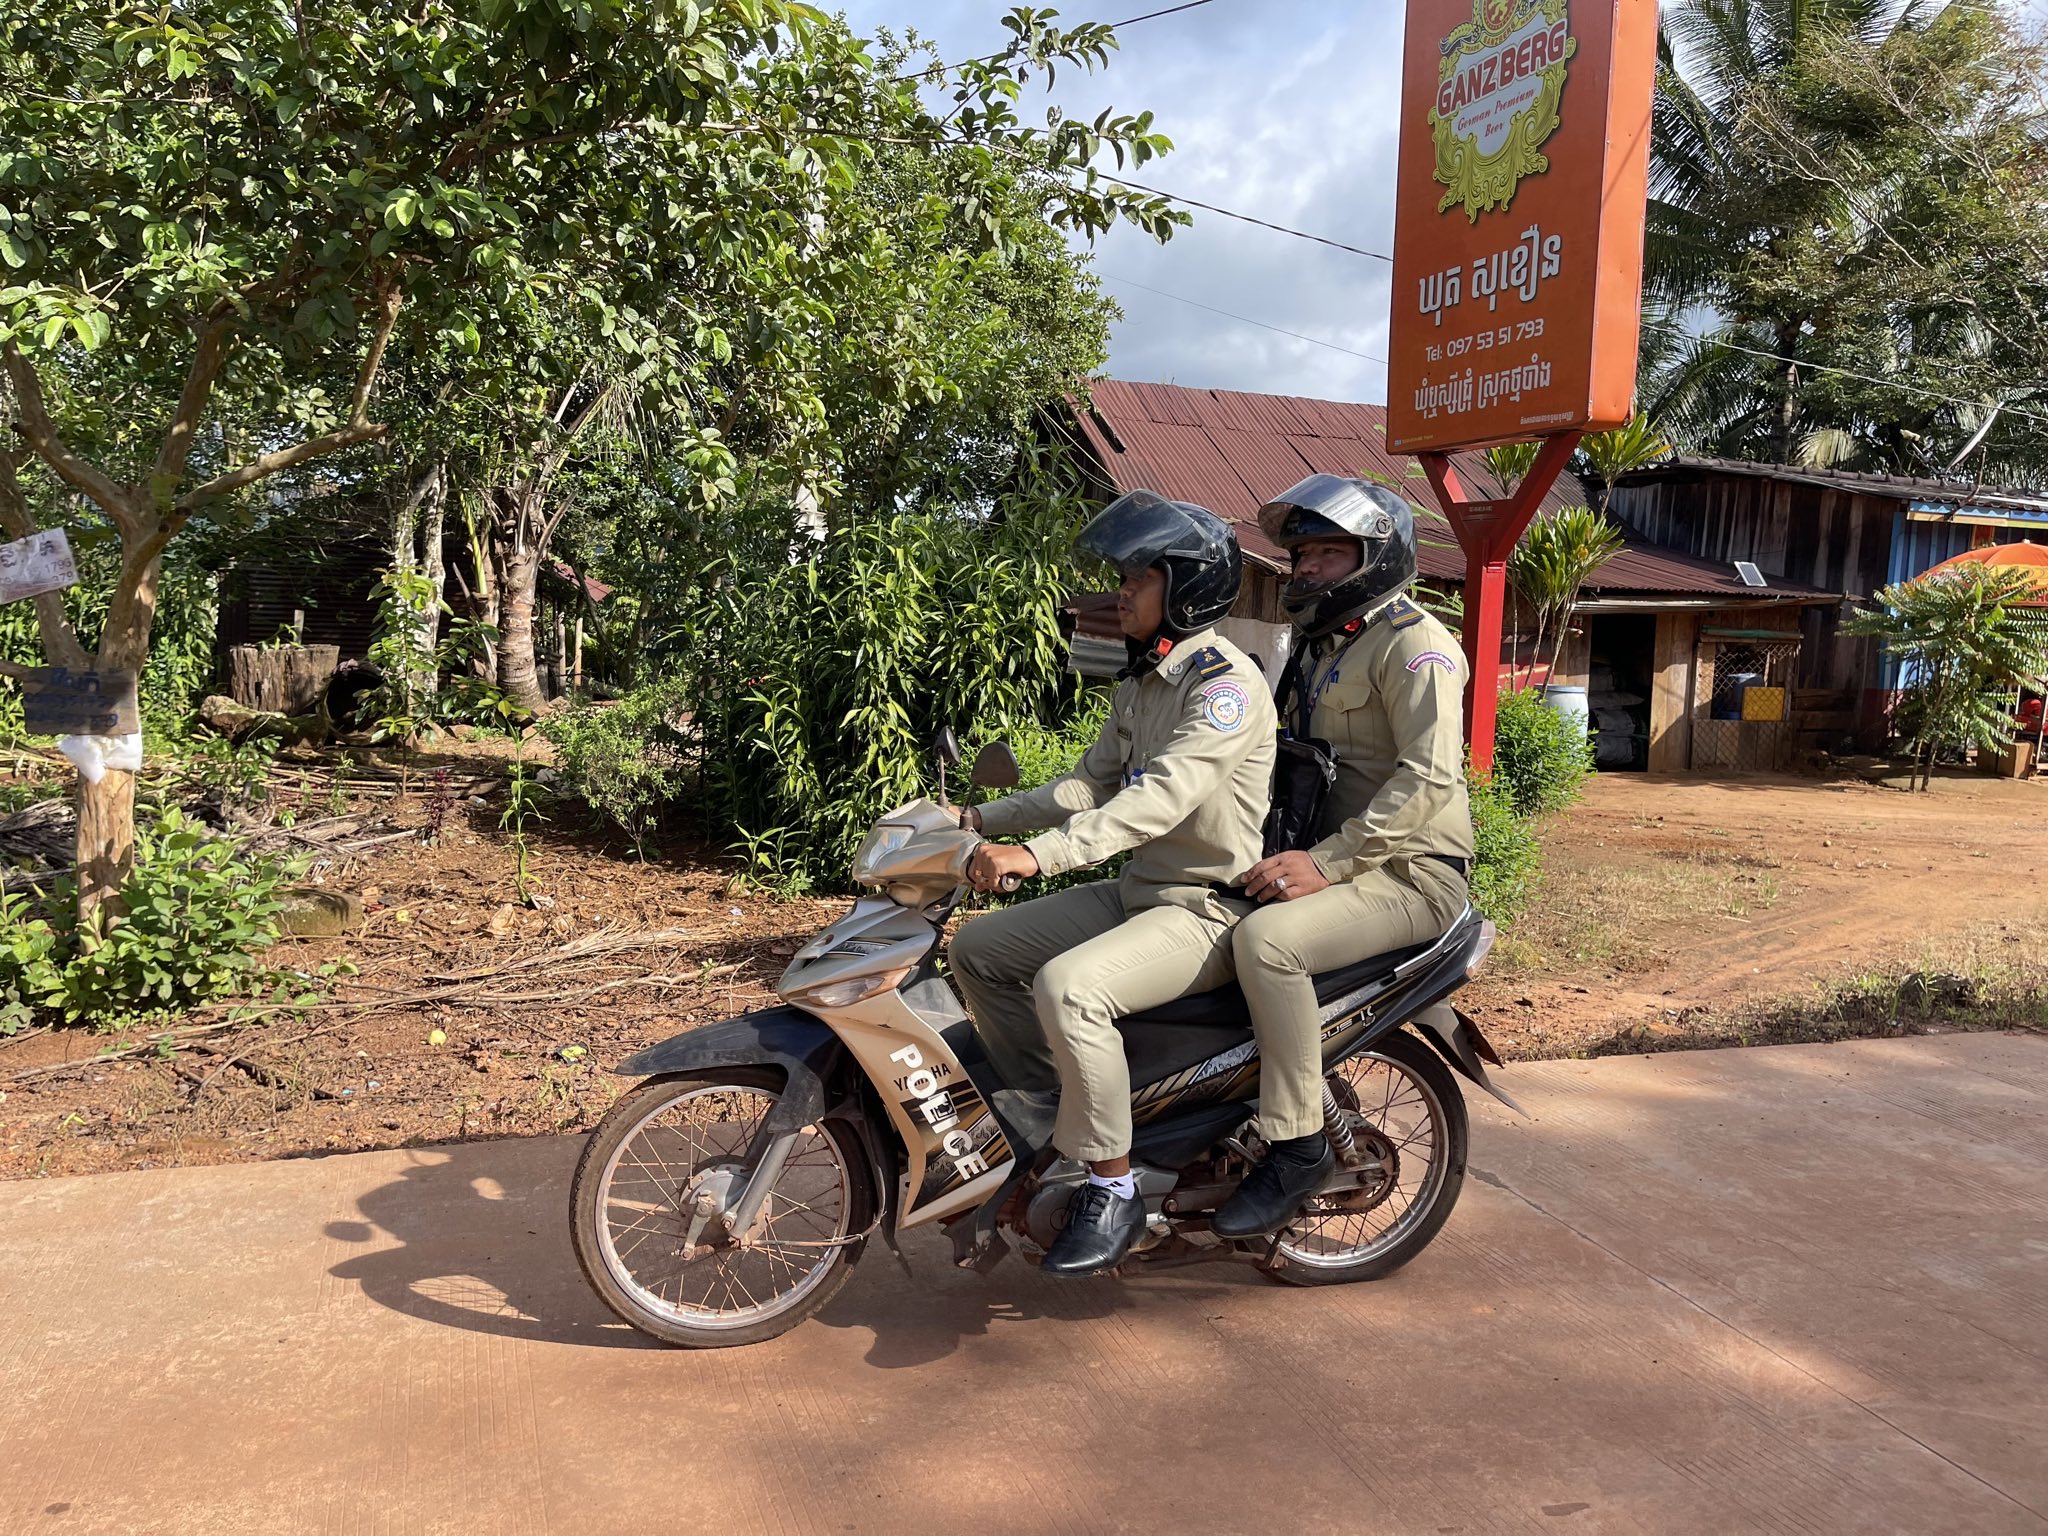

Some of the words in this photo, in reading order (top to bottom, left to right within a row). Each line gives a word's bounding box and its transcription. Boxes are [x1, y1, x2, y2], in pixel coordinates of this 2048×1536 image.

[1437, 24, 1567, 116] GANZBERG
[1457, 109, 1491, 131] German
[1495, 88, 1535, 114] Premium
[1485, 122, 1504, 137] Beer
[1425, 344, 1443, 363] Tel:
[1446, 336, 1473, 358] 097
[1476, 331, 1494, 351] 53
[1498, 326, 1512, 346] 51
[1515, 318, 1545, 342] 793
[889, 1043, 989, 1180] POLICE
